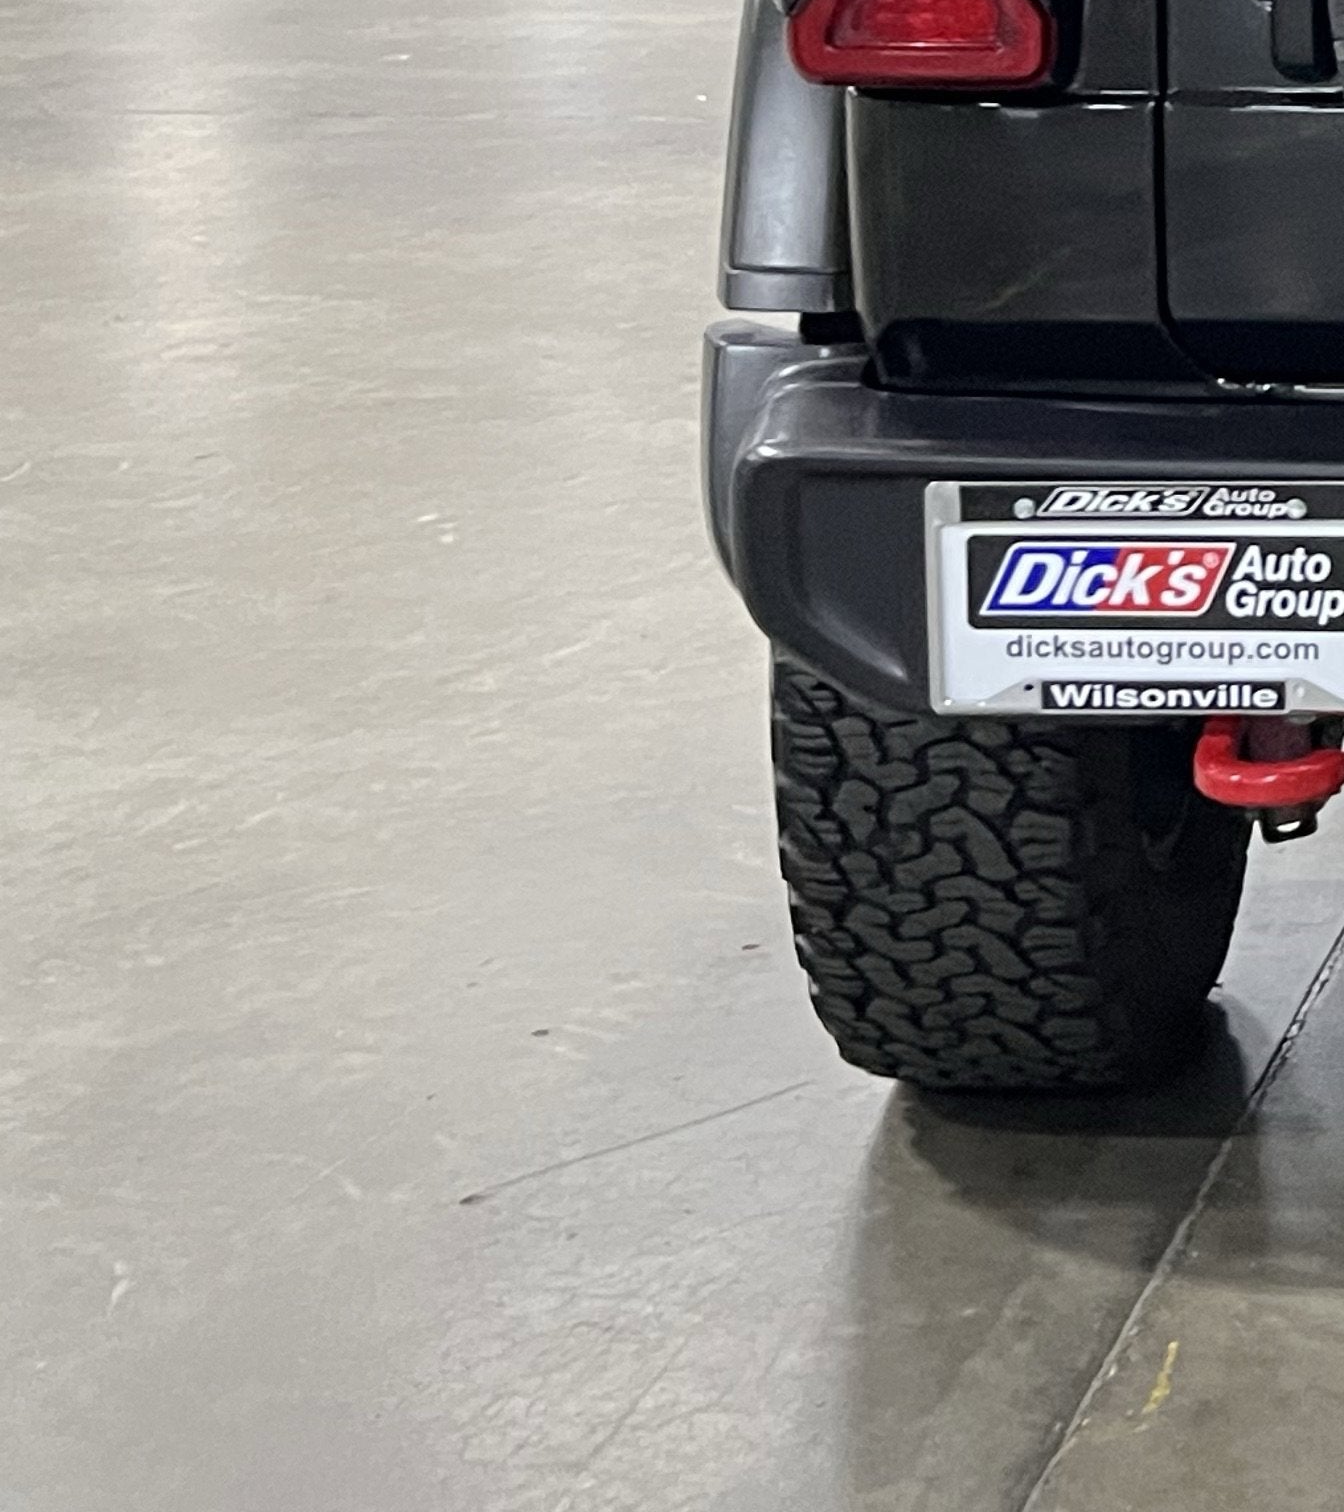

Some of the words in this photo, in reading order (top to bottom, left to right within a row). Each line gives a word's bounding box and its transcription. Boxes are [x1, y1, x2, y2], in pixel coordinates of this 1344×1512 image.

[1211, 487, 1276, 502] Auto
[1203, 500, 1288, 519] Group
[1231, 544, 1331, 583] Auto
[1006, 635, 1319, 664] dicksautogroup.com
[1050, 683, 1279, 708] Wilsonville
